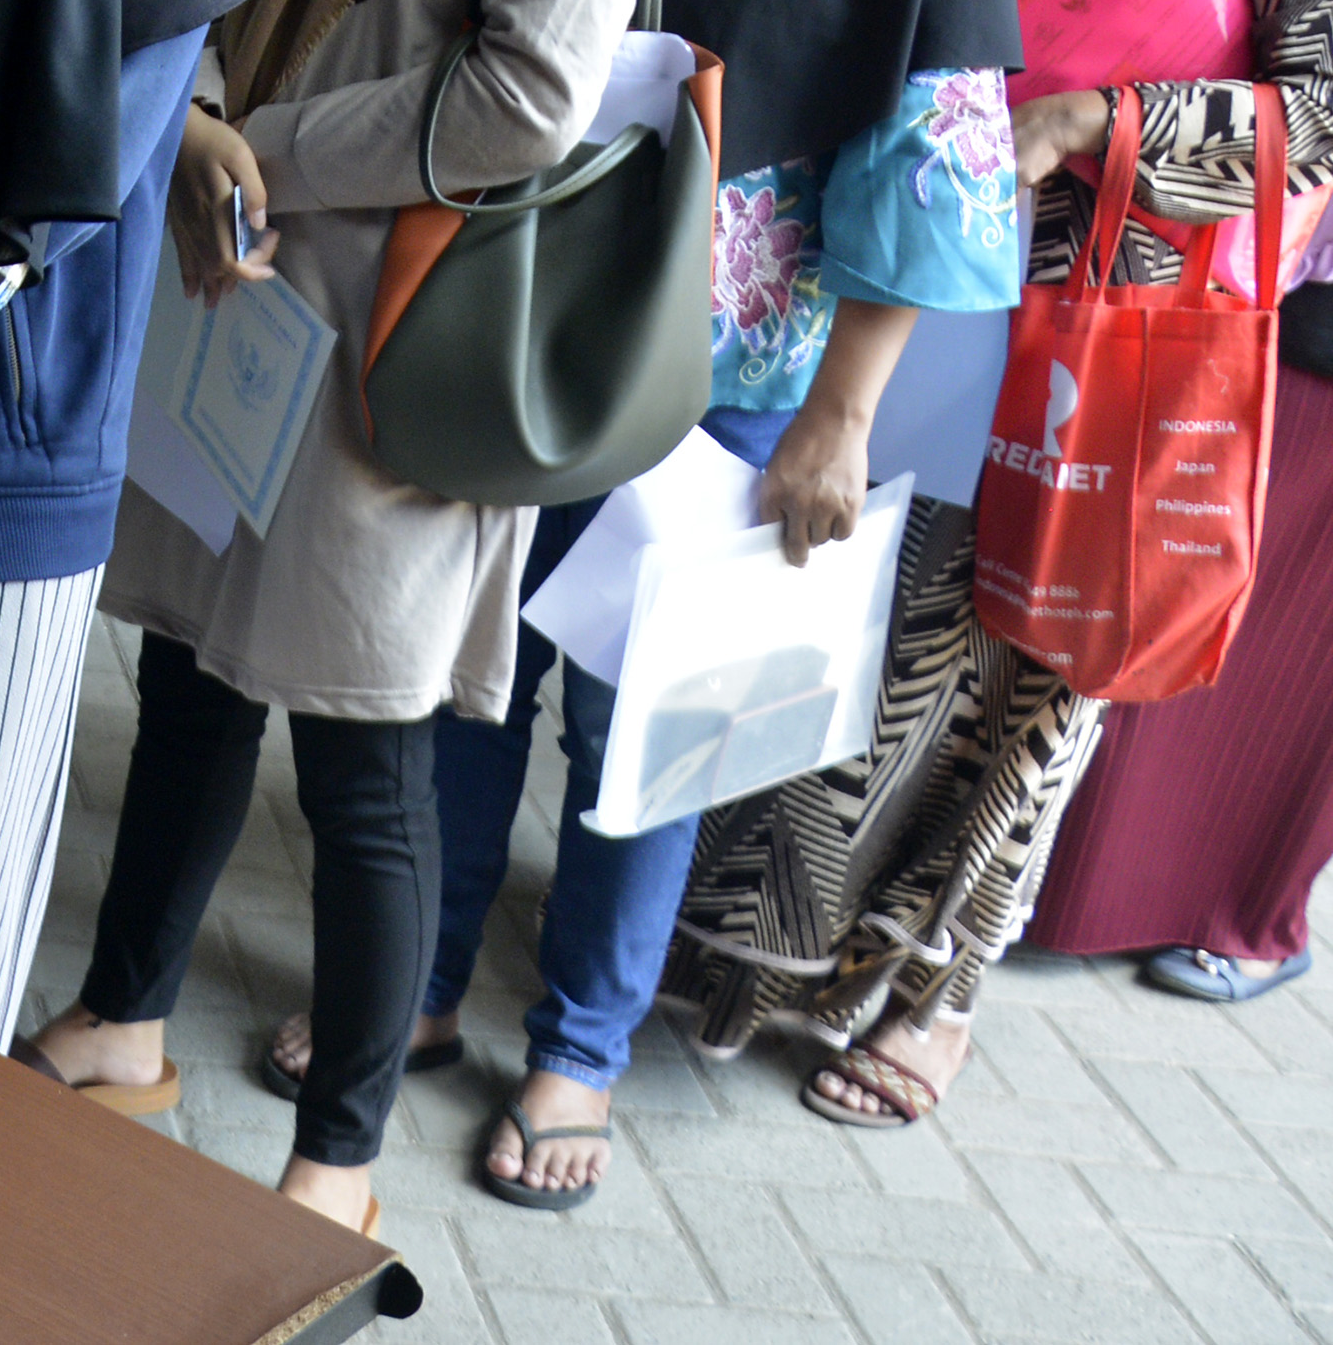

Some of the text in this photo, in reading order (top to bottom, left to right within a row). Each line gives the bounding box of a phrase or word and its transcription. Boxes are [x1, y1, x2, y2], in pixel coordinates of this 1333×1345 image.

[1159, 419, 1236, 433] INDONESIA
[1175, 459, 1215, 475] Japan
[1156, 498, 1232, 515] Philippines
[1161, 539, 1222, 555] Thailand
